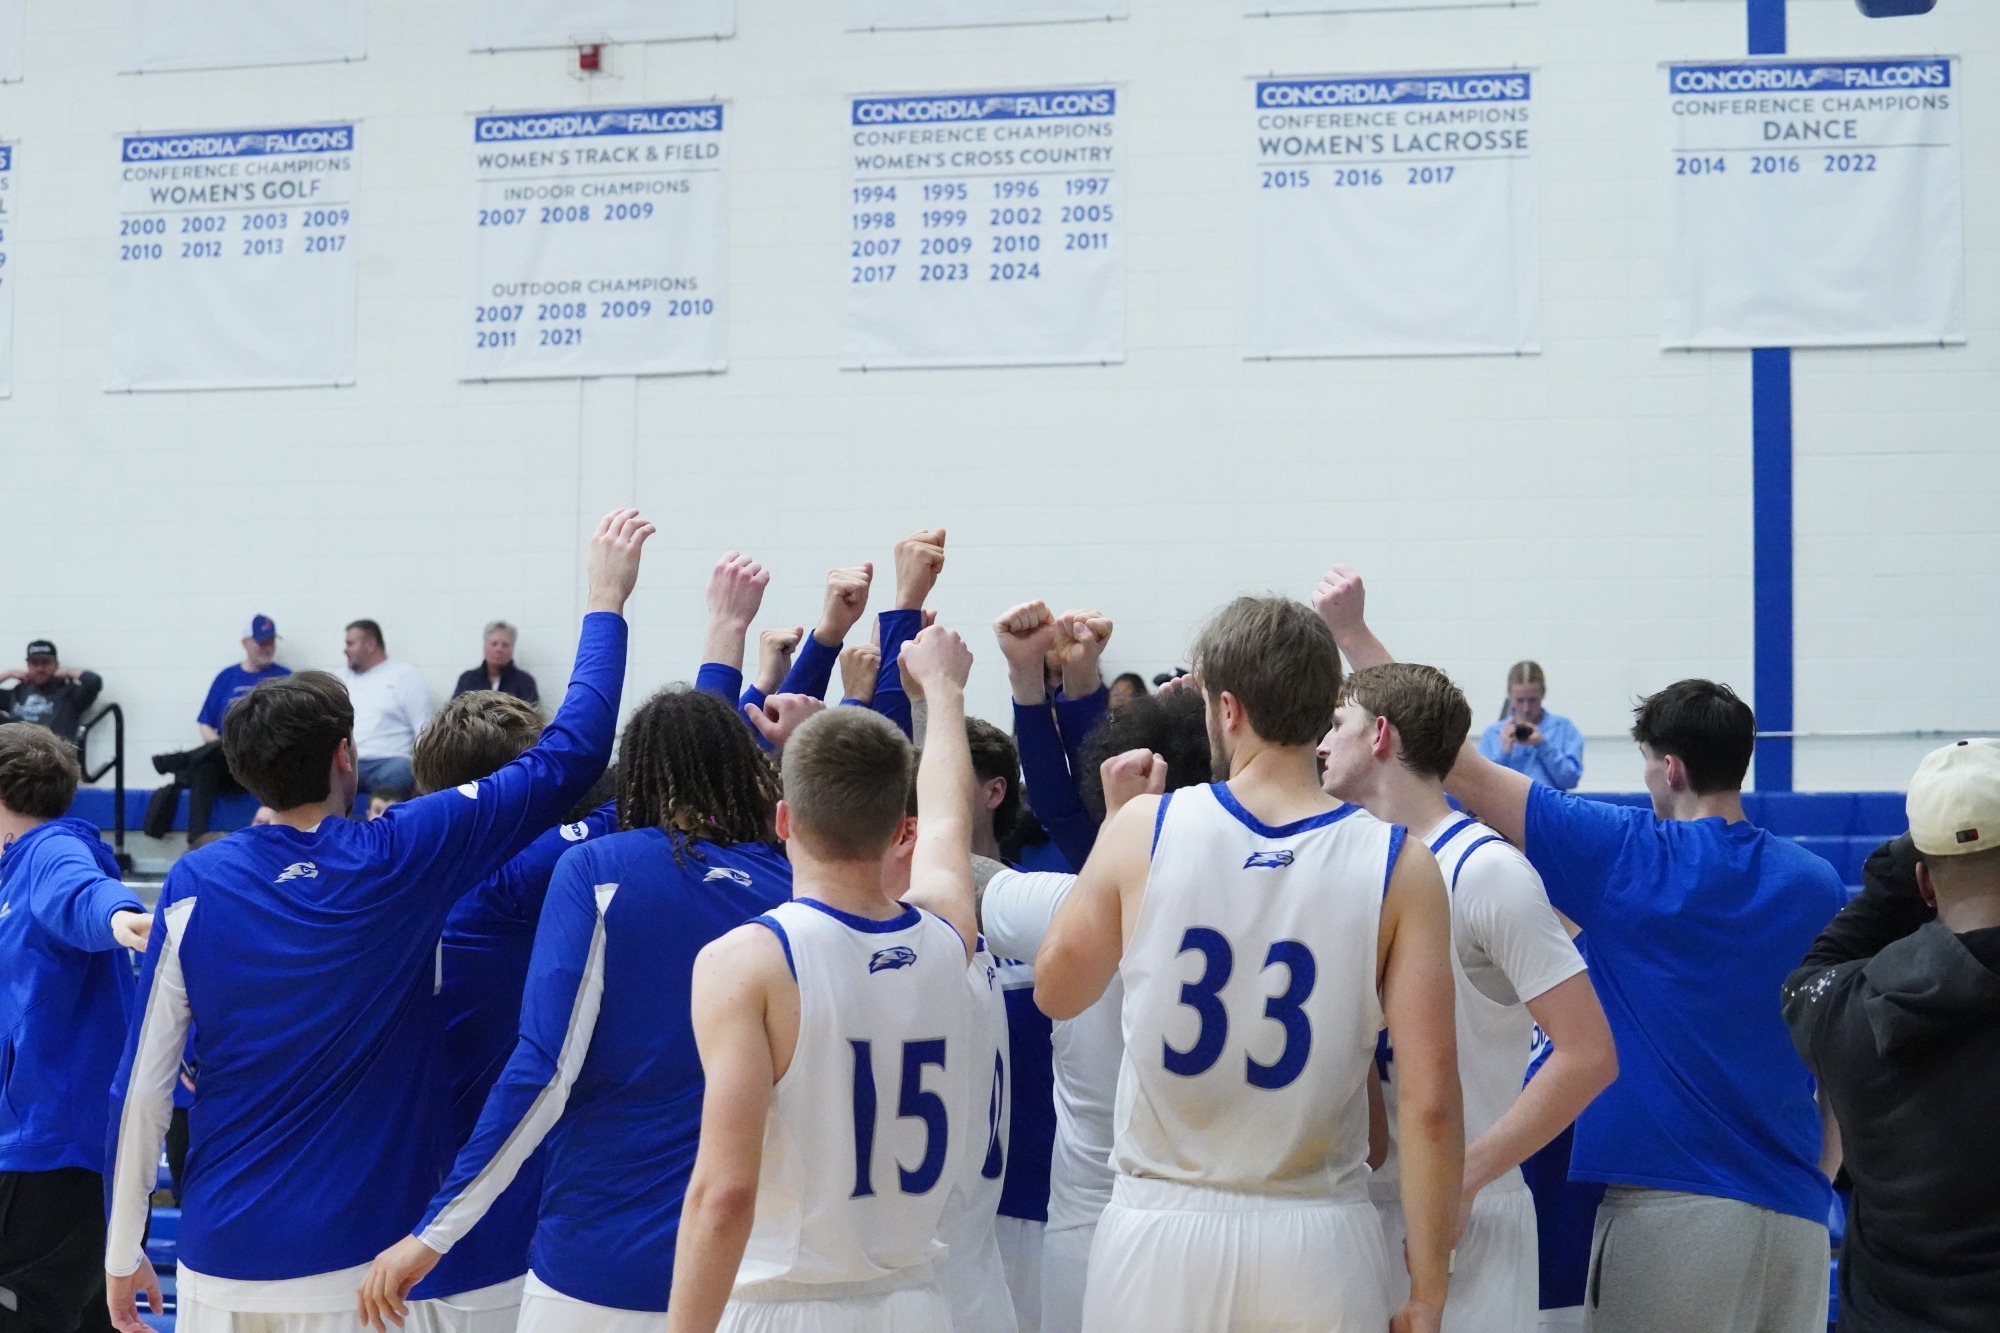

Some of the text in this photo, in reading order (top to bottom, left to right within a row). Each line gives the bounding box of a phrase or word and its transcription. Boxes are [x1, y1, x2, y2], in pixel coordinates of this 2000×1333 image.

[1675, 66, 1944, 91] CONCORDIA FALCONS
[1262, 79, 1524, 106] CONCORDIA FALCONS
[857, 94, 1110, 122] CONCORDIA FALCONS
[1672, 95, 1949, 116] CONFERENCE CHAMPIONS
[479, 109, 717, 140] CONCORDIA FALCONS
[1258, 108, 1528, 130] CONFERENCE CHAMPIONS
[1763, 120, 1857, 140] DANCE
[127, 130, 348, 159] CONCORDIA FALCONS
[854, 123, 1112, 146] CONFERENCE CHAMPIONS
[1259, 130, 1528, 156] WOMEN'S LACROSSE
[575, 147, 638, 164] TRACK
[646, 146, 658, 161] &
[665, 143, 719, 160] FIELD
[855, 147, 1112, 170] WOMEN'S CROSS COUNTRY
[1676, 154, 1877, 175] 2014 2016 2022
[123, 157, 350, 181] CONFERENCE CHAMPIONS
[1262, 167, 1455, 188] 2015 2016 2017
[150, 179, 321, 204] WOMEN'S GOLF
[504, 180, 690, 201] INDOOR CHAMPIONS
[852, 178, 1109, 203] 1994 1995 1996 1997
[120, 210, 349, 236] 2000 2002 2003 2009
[478, 203, 654, 226] 2007 2008 2009
[852, 205, 1113, 229] 1998 1999 2002 2005
[121, 236, 346, 261] 2010 2012 2013 2017
[852, 233, 1108, 258] 2007 2009 2010 2011
[852, 263, 1040, 283] 2017 2023 2024
[492, 277, 697, 297] OUTDOOR CHAMPIONS
[476, 299, 713, 322] 2007 2008 2009 2010
[476, 329, 582, 348] 2011 2021
[1162, 925, 1317, 1091] 33
[846, 1036, 949, 1199] 15
